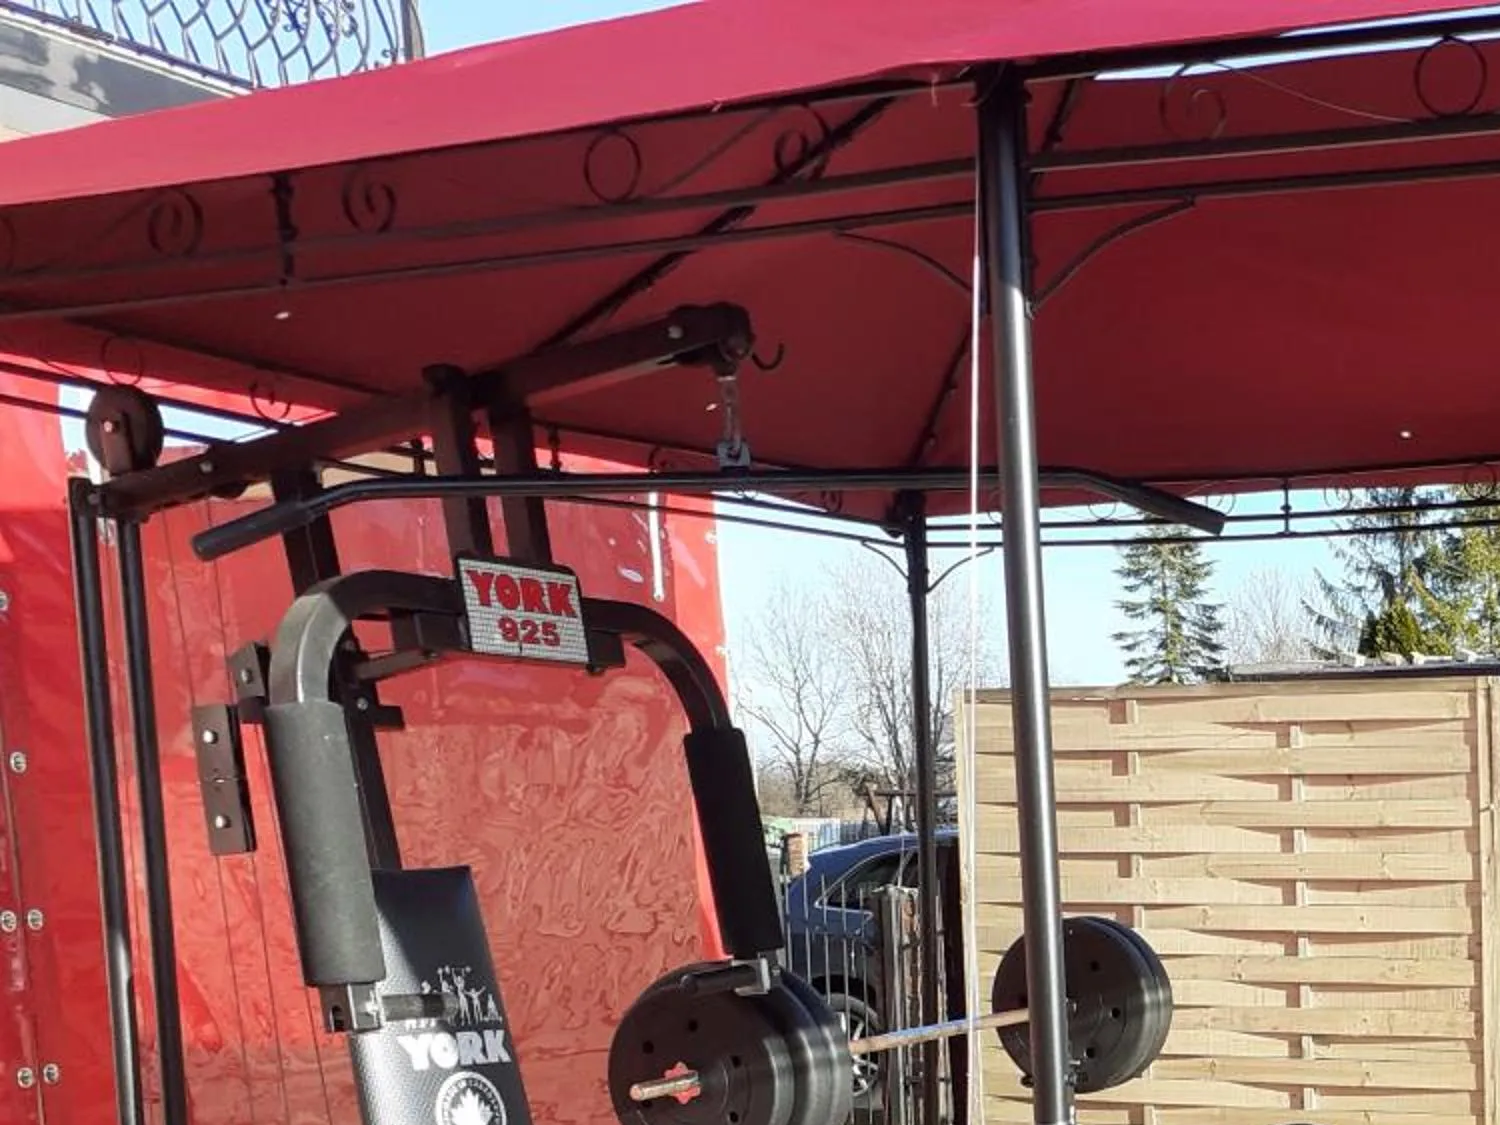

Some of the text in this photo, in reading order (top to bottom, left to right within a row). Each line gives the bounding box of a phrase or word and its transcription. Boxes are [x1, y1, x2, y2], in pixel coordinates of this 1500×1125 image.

[465, 569, 578, 618] YORK
[498, 615, 561, 646] 925
[396, 1029, 512, 1071] YORK
